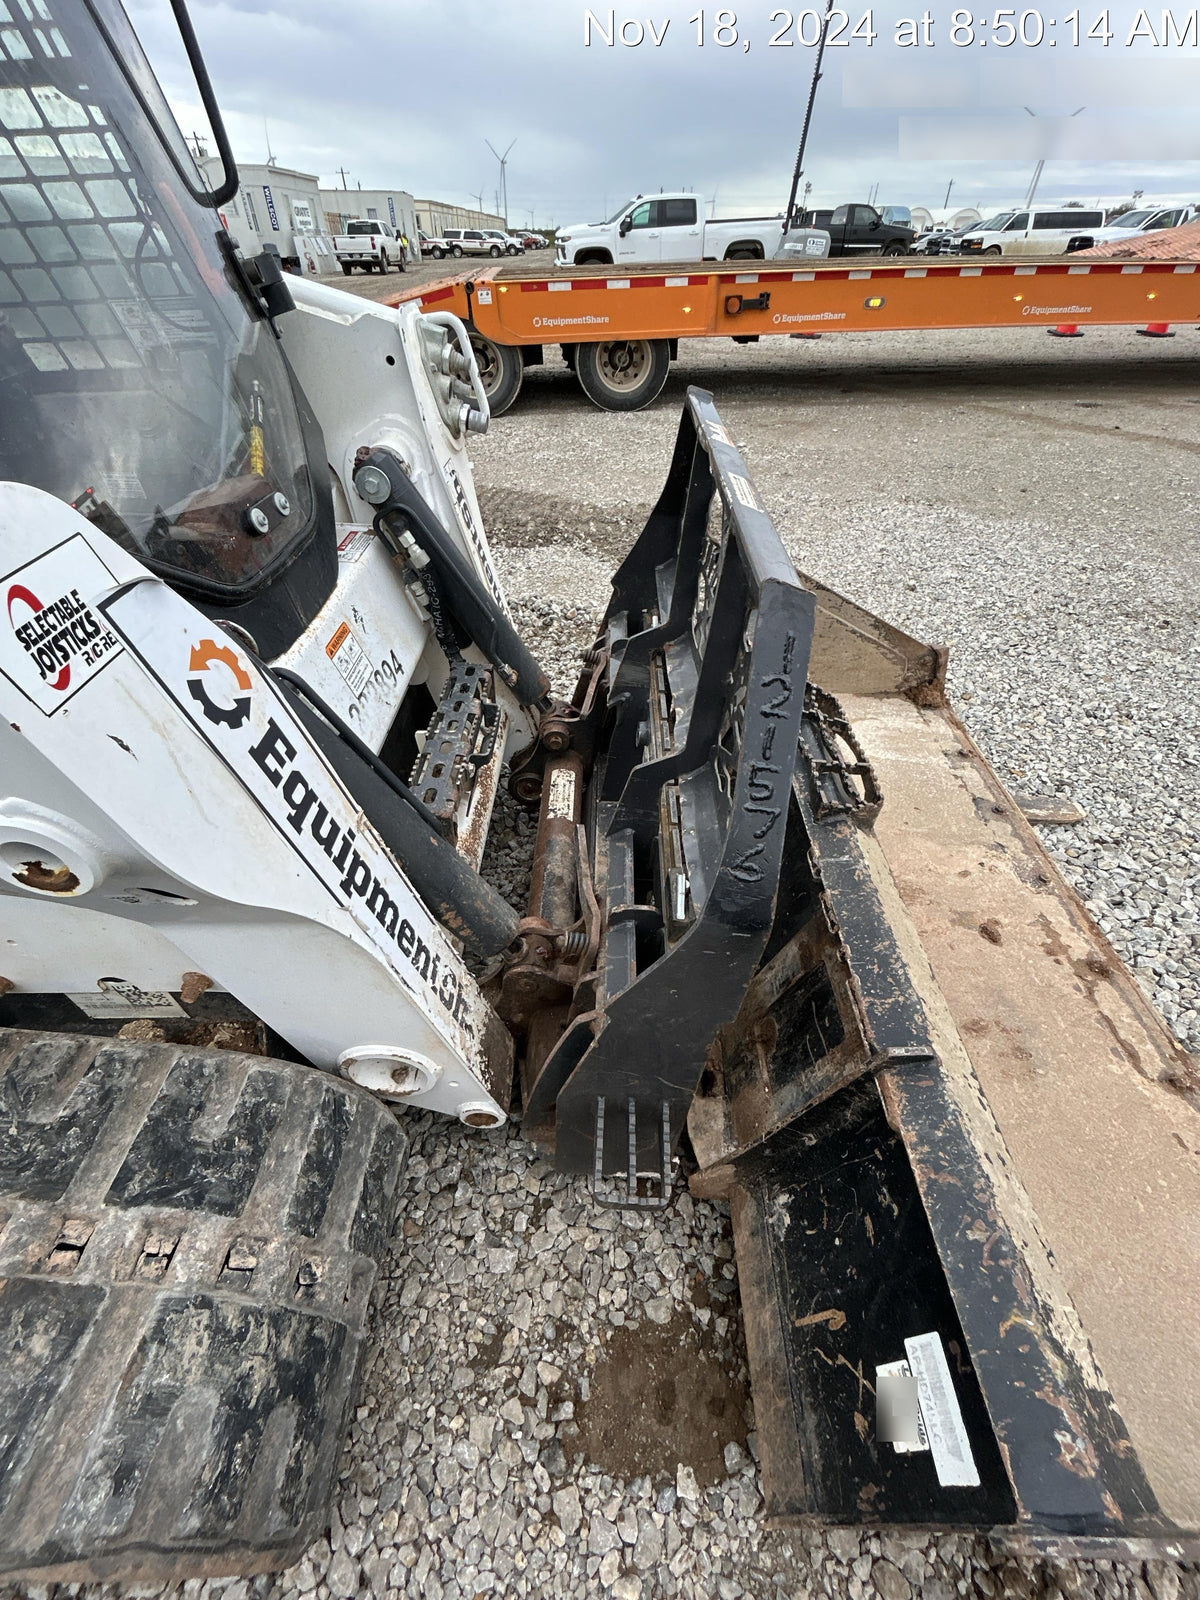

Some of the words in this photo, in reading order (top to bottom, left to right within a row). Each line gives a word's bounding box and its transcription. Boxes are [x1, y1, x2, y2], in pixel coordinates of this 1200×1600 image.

[264, 187, 279, 230] WILLSCOT
[782, 312, 846, 323] EquipmentShare
[1030, 305, 1092, 315] EquipmentShare
[542, 315, 609, 328] EquipmentShare
[15, 588, 87, 652] SELECTABLE
[30, 610, 101, 680] JOYSTICKS
[101, 631, 118, 652] RE
